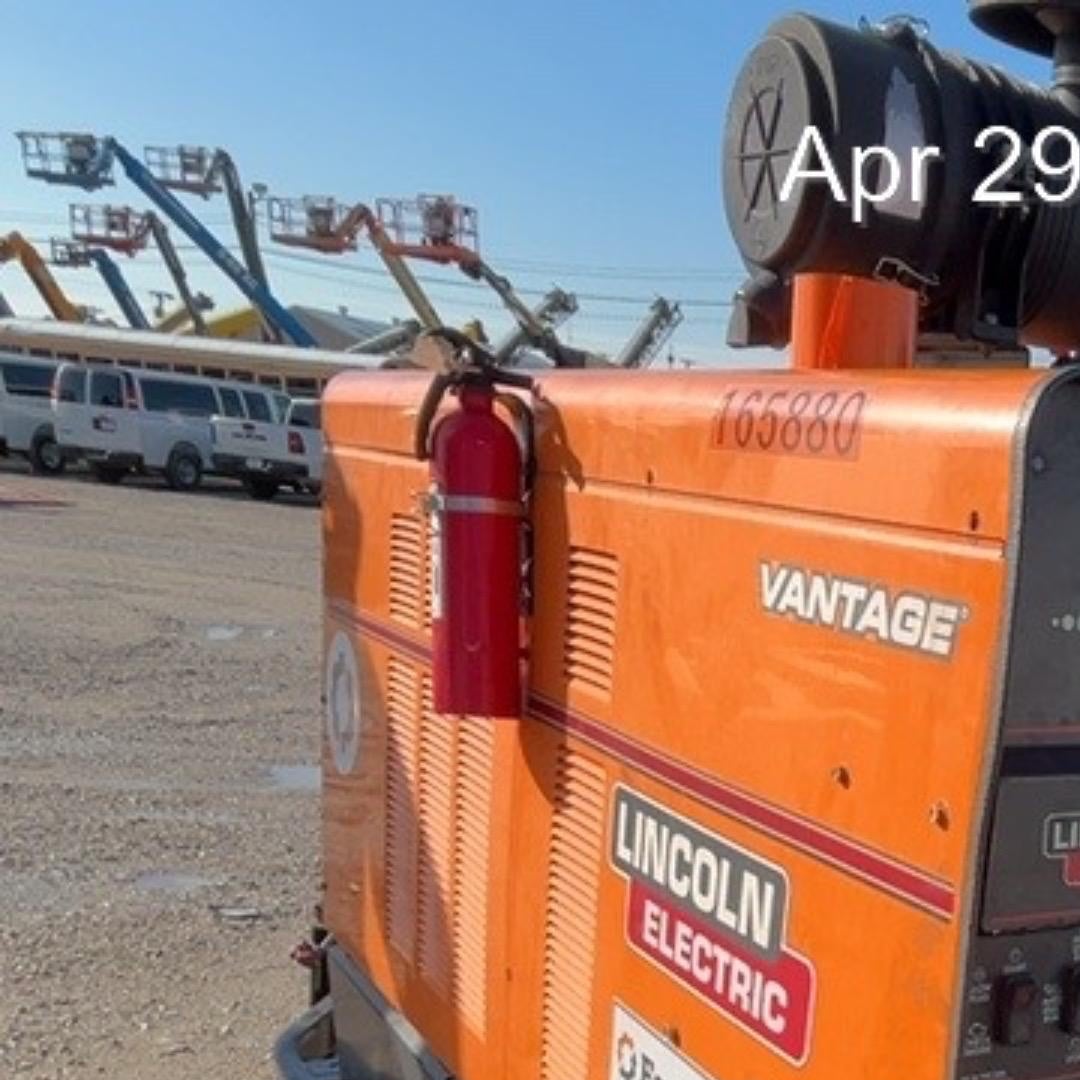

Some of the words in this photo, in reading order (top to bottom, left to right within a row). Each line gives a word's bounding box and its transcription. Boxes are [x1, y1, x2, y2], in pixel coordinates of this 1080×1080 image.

[713, 388, 866, 456] 165880
[760, 563, 960, 654] VANTAGE
[616, 800, 776, 948] LINCOLN
[642, 899, 790, 1035] ELECTRIC
